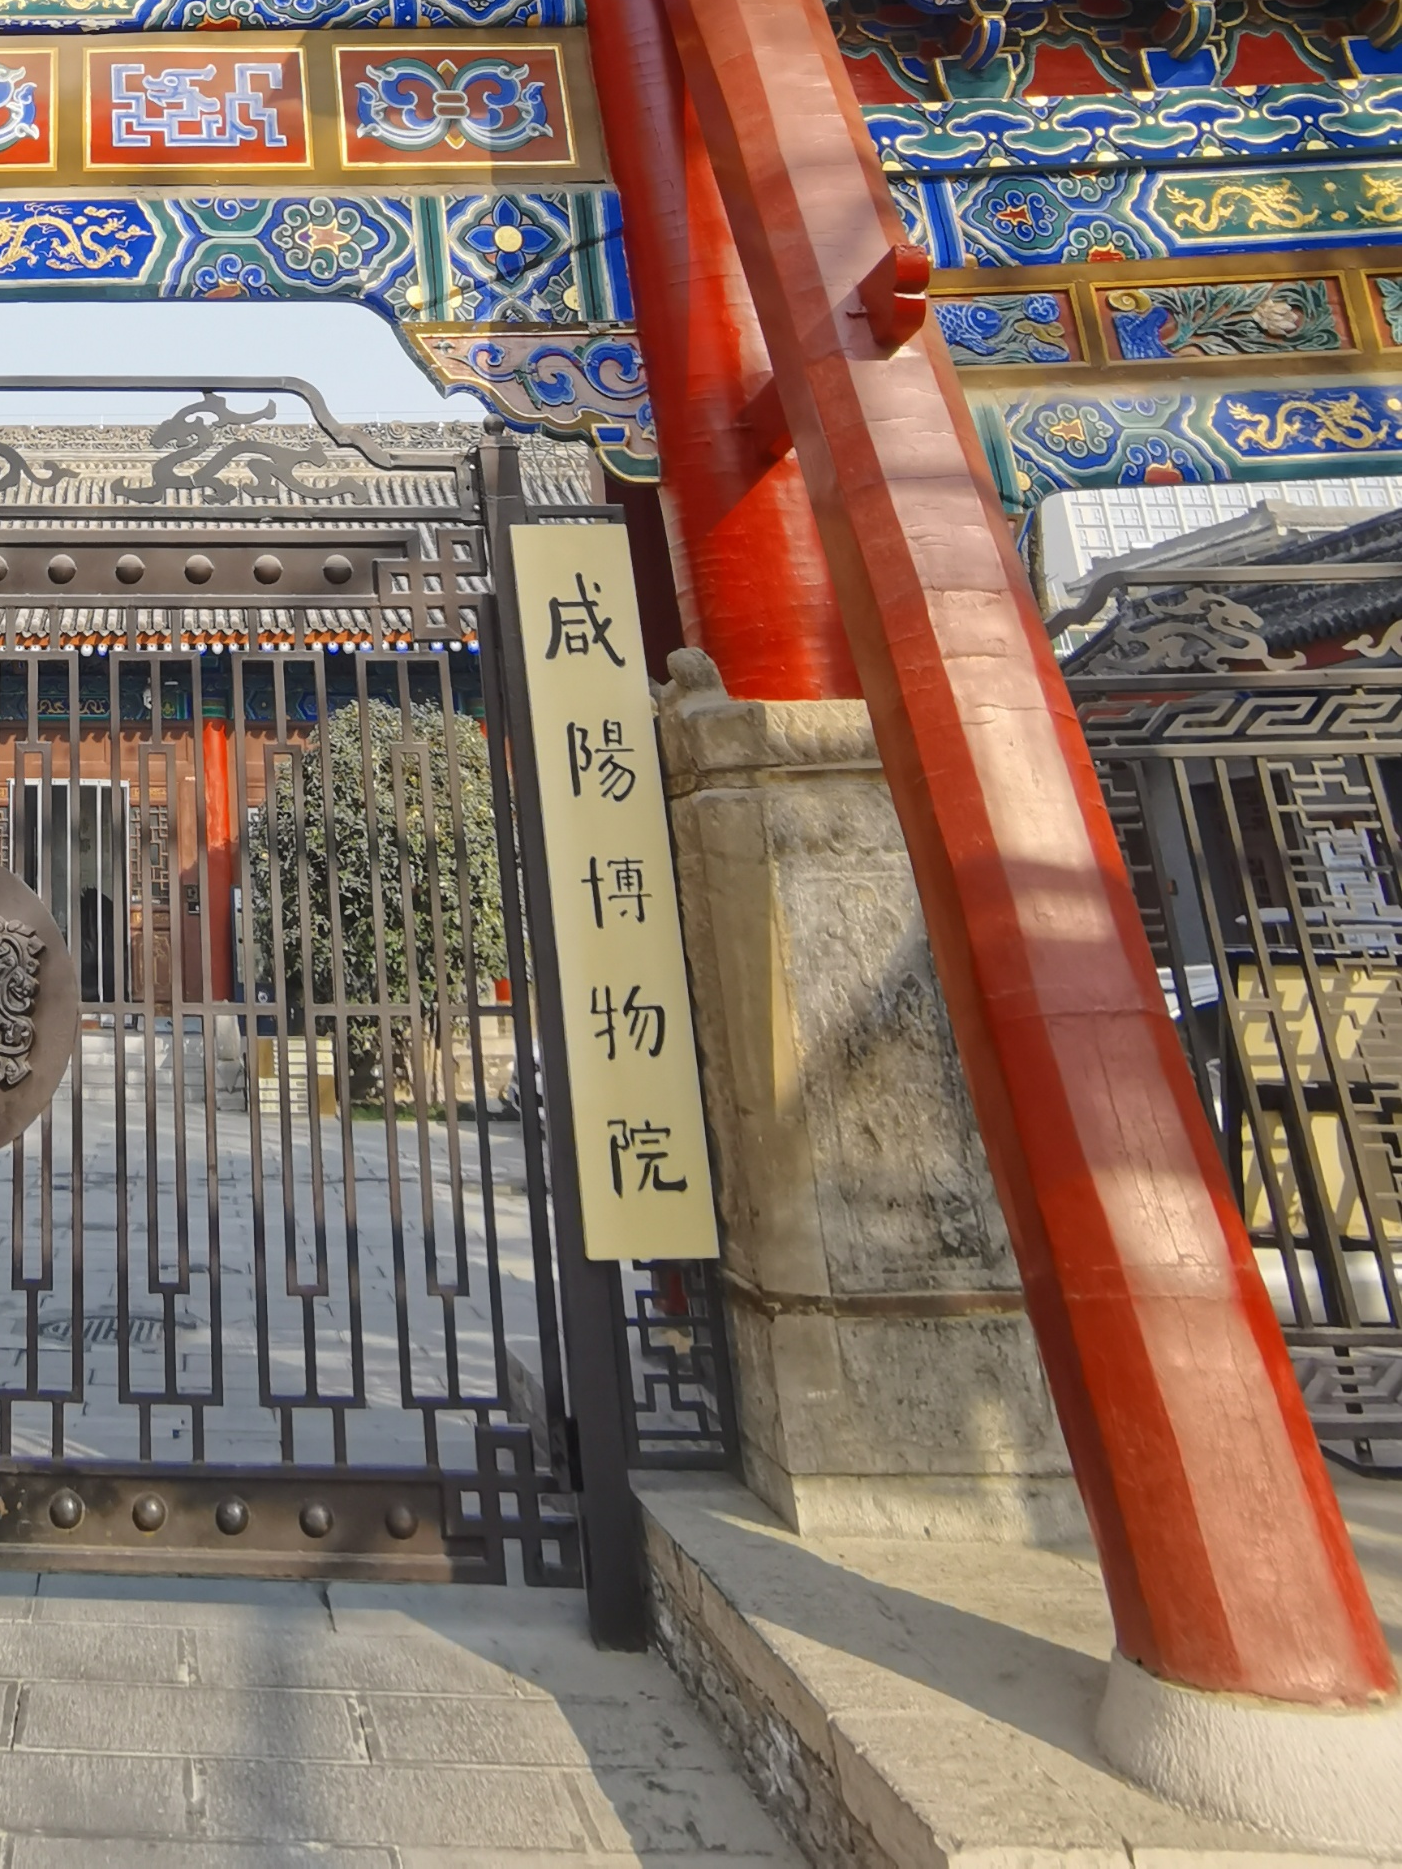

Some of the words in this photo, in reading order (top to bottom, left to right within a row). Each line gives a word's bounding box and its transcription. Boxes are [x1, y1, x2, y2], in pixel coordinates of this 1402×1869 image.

[543, 570, 688, 1200] 咸陽博物院
